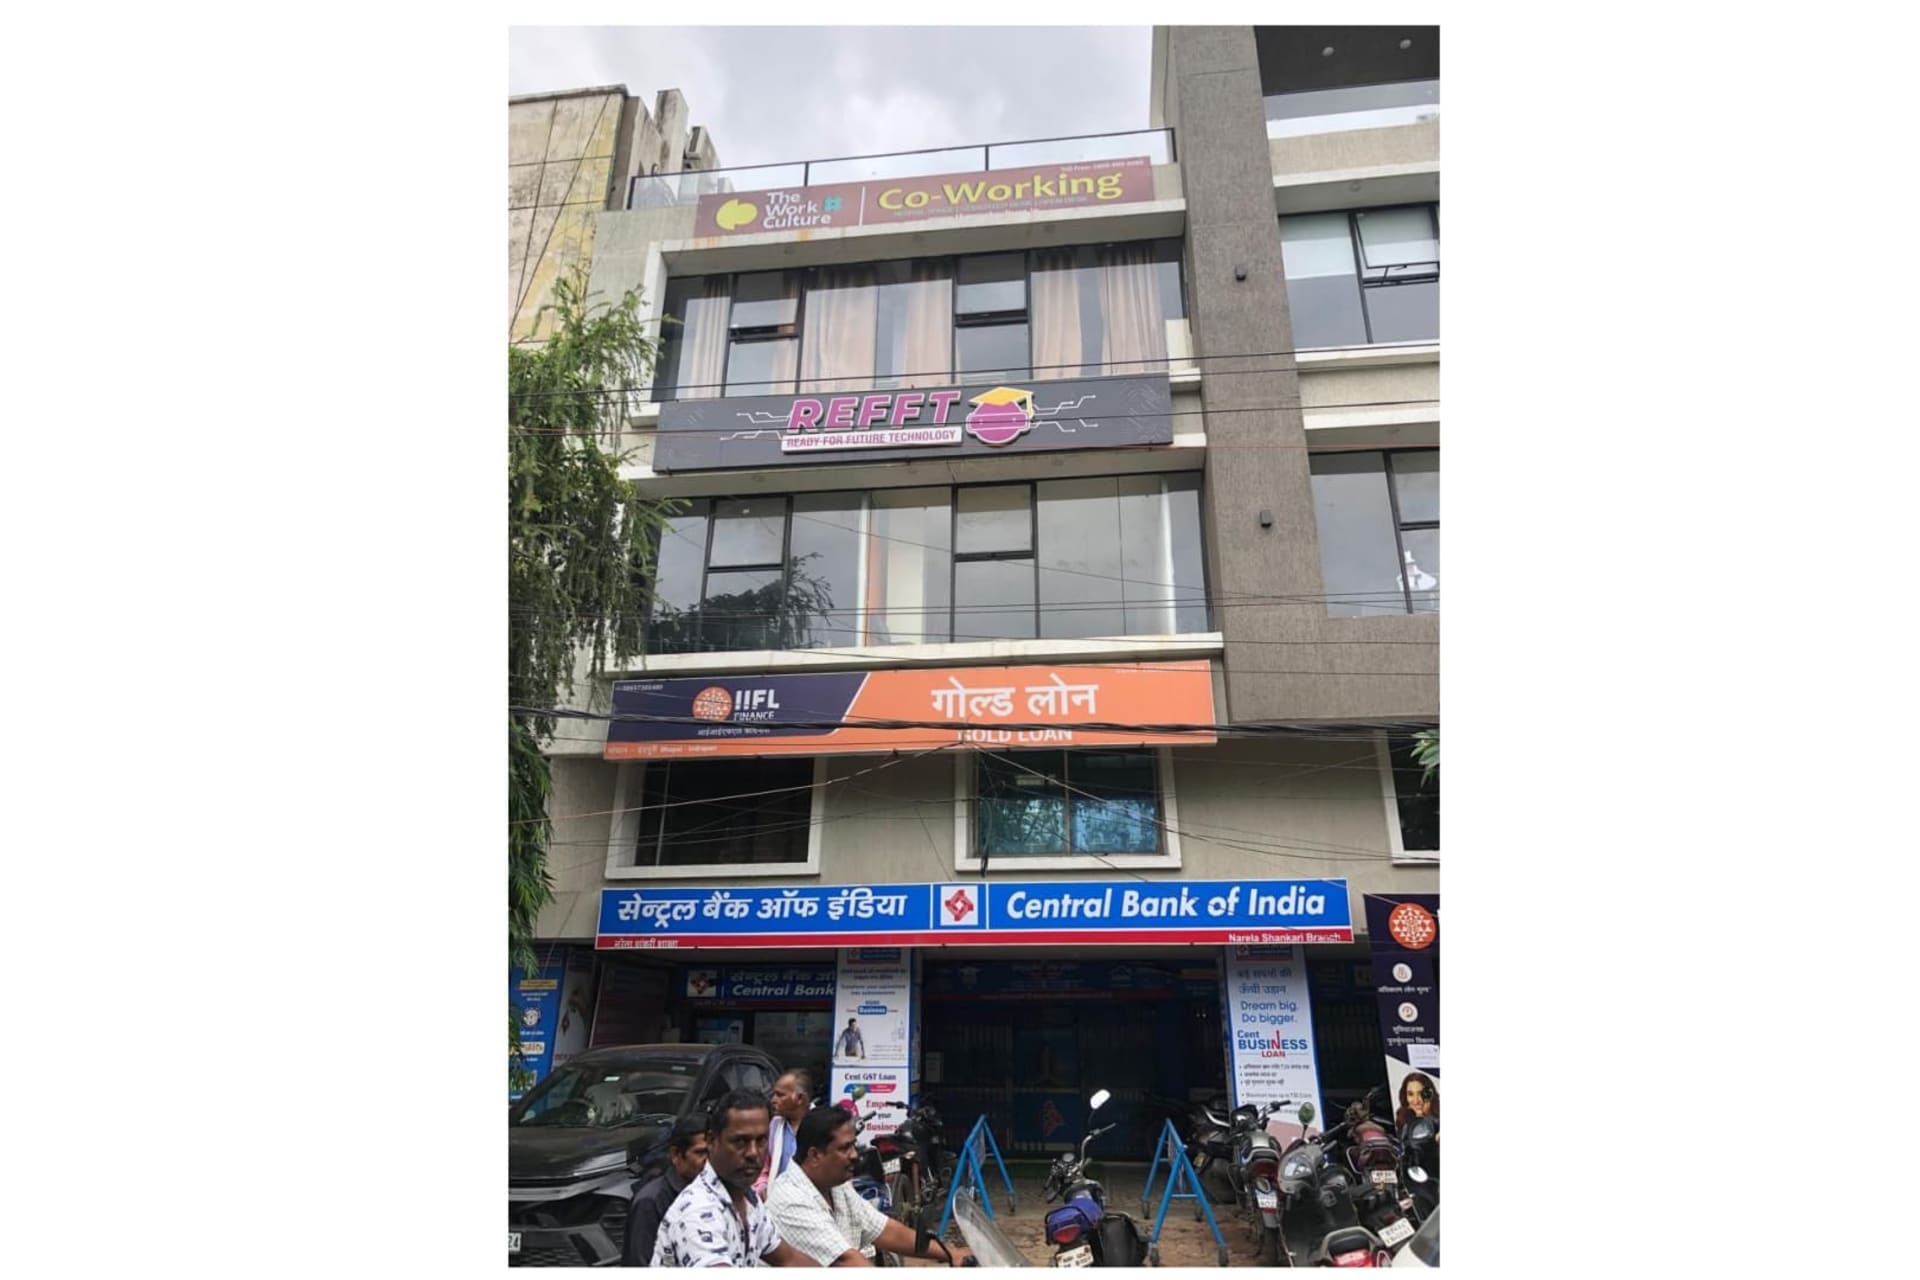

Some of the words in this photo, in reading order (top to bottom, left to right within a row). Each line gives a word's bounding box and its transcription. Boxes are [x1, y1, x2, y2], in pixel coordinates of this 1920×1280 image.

[766, 191, 801, 205] The
[878, 172, 1123, 211] Co-Working
[765, 201, 818, 215] Work
[762, 211, 830, 229] Culture
[788, 390, 962, 433] REFFT
[787, 436, 819, 447] READY
[822, 434, 840, 446] FOR
[842, 433, 886, 445] FUTURE
[889, 429, 956, 443] TECHNOLOGY
[733, 688, 780, 711] IIFL
[931, 675, 1015, 719] गोल्ड
[1025, 671, 1099, 717] लोन
[733, 711, 775, 721] FINANCE
[1018, 728, 1073, 742] LOAN
[617, 891, 699, 929] सेन्ट्रल
[702, 890, 753, 920] बैंक
[756, 889, 820, 920] ऑफ
[827, 887, 909, 920] इंडिया
[1006, 887, 1112, 919] Central
[1121, 885, 1200, 918] Bank
[1207, 886, 1240, 917] of
[1248, 885, 1325, 916] India
[1228, 932, 1259, 943] Narela
[1261, 932, 1303, 943] Shankari
[1306, 932, 1341, 943] Branch
[732, 984, 789, 997] Central
[794, 983, 835, 996] Bank
[1240, 1000, 1276, 1011] Dream
[1277, 1000, 1297, 1013] big.
[1241, 1014, 1257, 1023] Do
[1259, 1013, 1297, 1026] bigger.
[1237, 1030, 1260, 1039] Cent
[1238, 1031, 1308, 1050] BUSINESS
[1261, 1050, 1286, 1058] LOAN
[862, 1072, 877, 1080] GST
[879, 1072, 896, 1080] Loan
